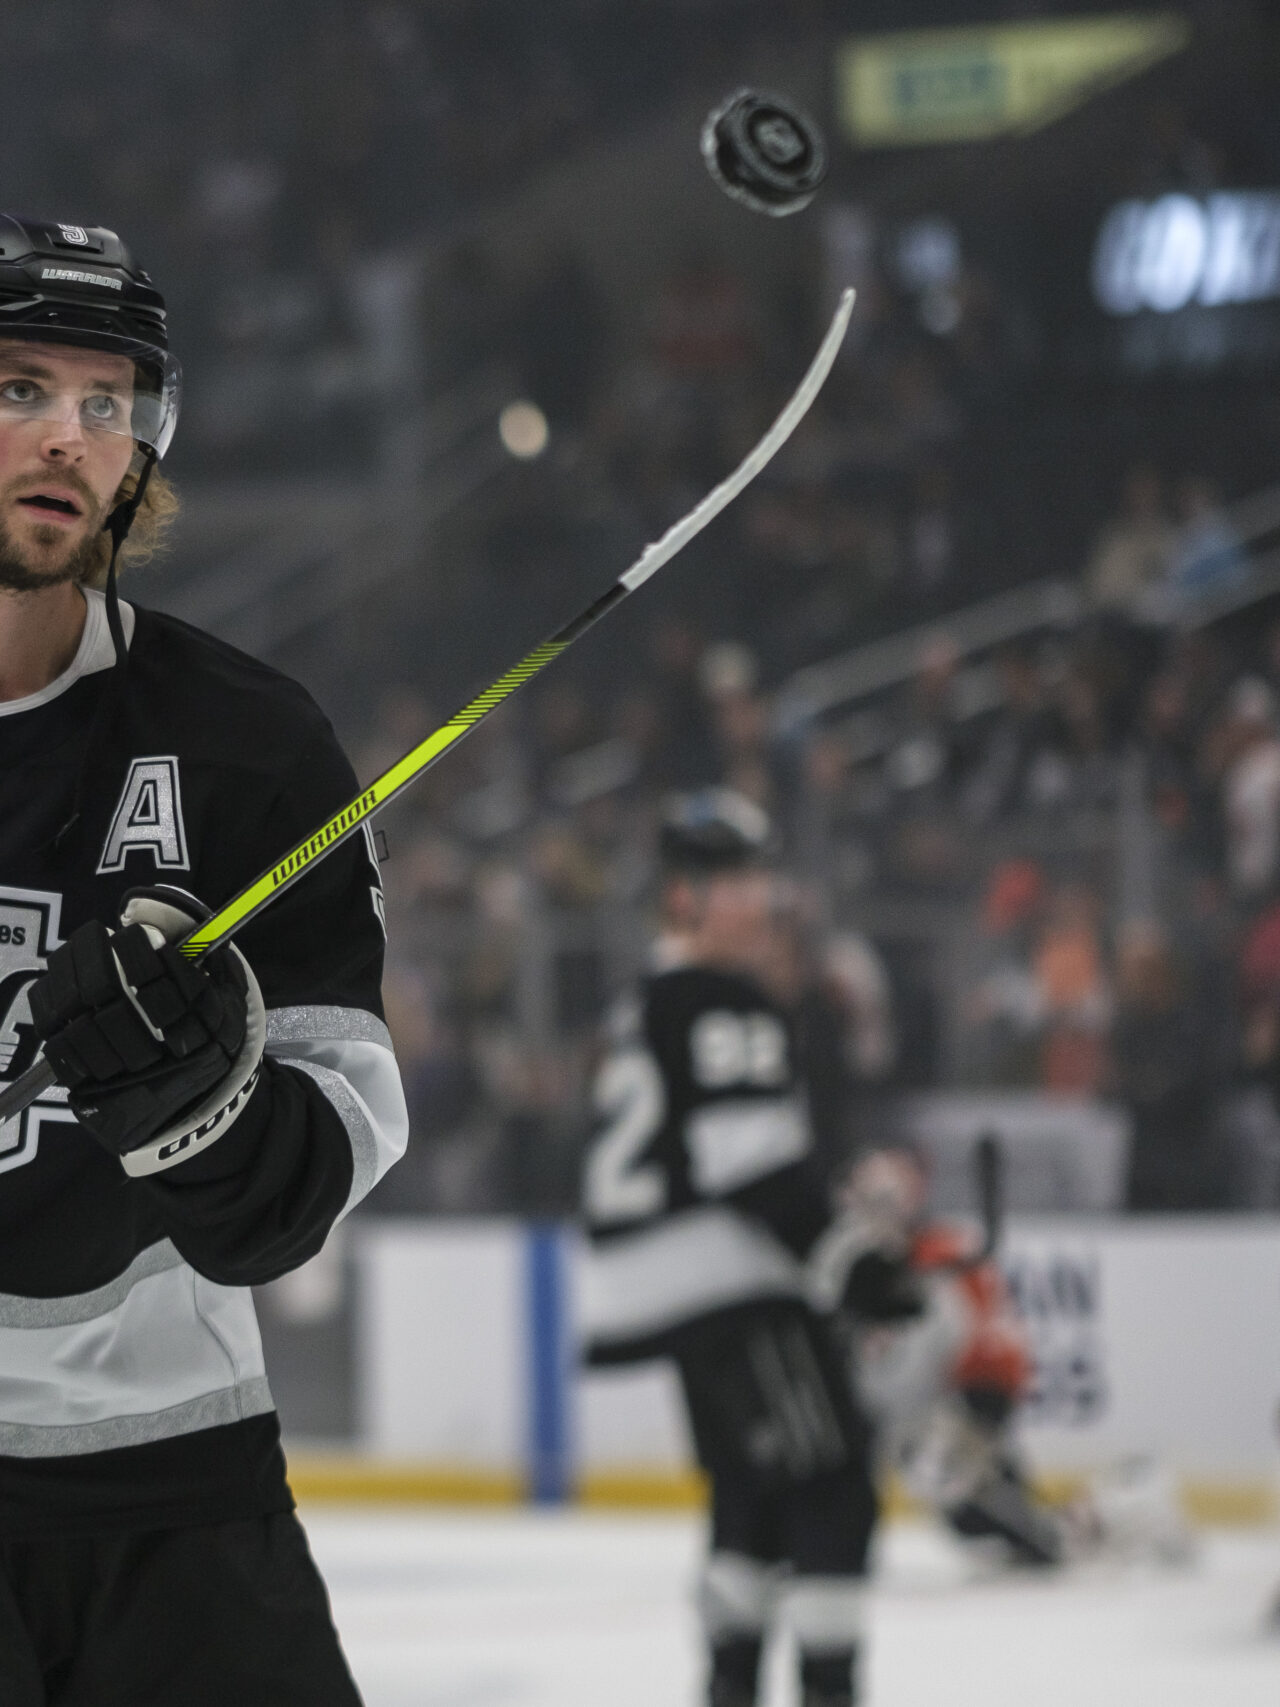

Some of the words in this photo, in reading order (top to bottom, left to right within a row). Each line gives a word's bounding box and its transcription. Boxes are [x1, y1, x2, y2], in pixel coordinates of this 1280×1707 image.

[41, 268, 123, 291] WARRIOR
[95, 755, 191, 876] A
[272, 789, 377, 887] WARRIOR
